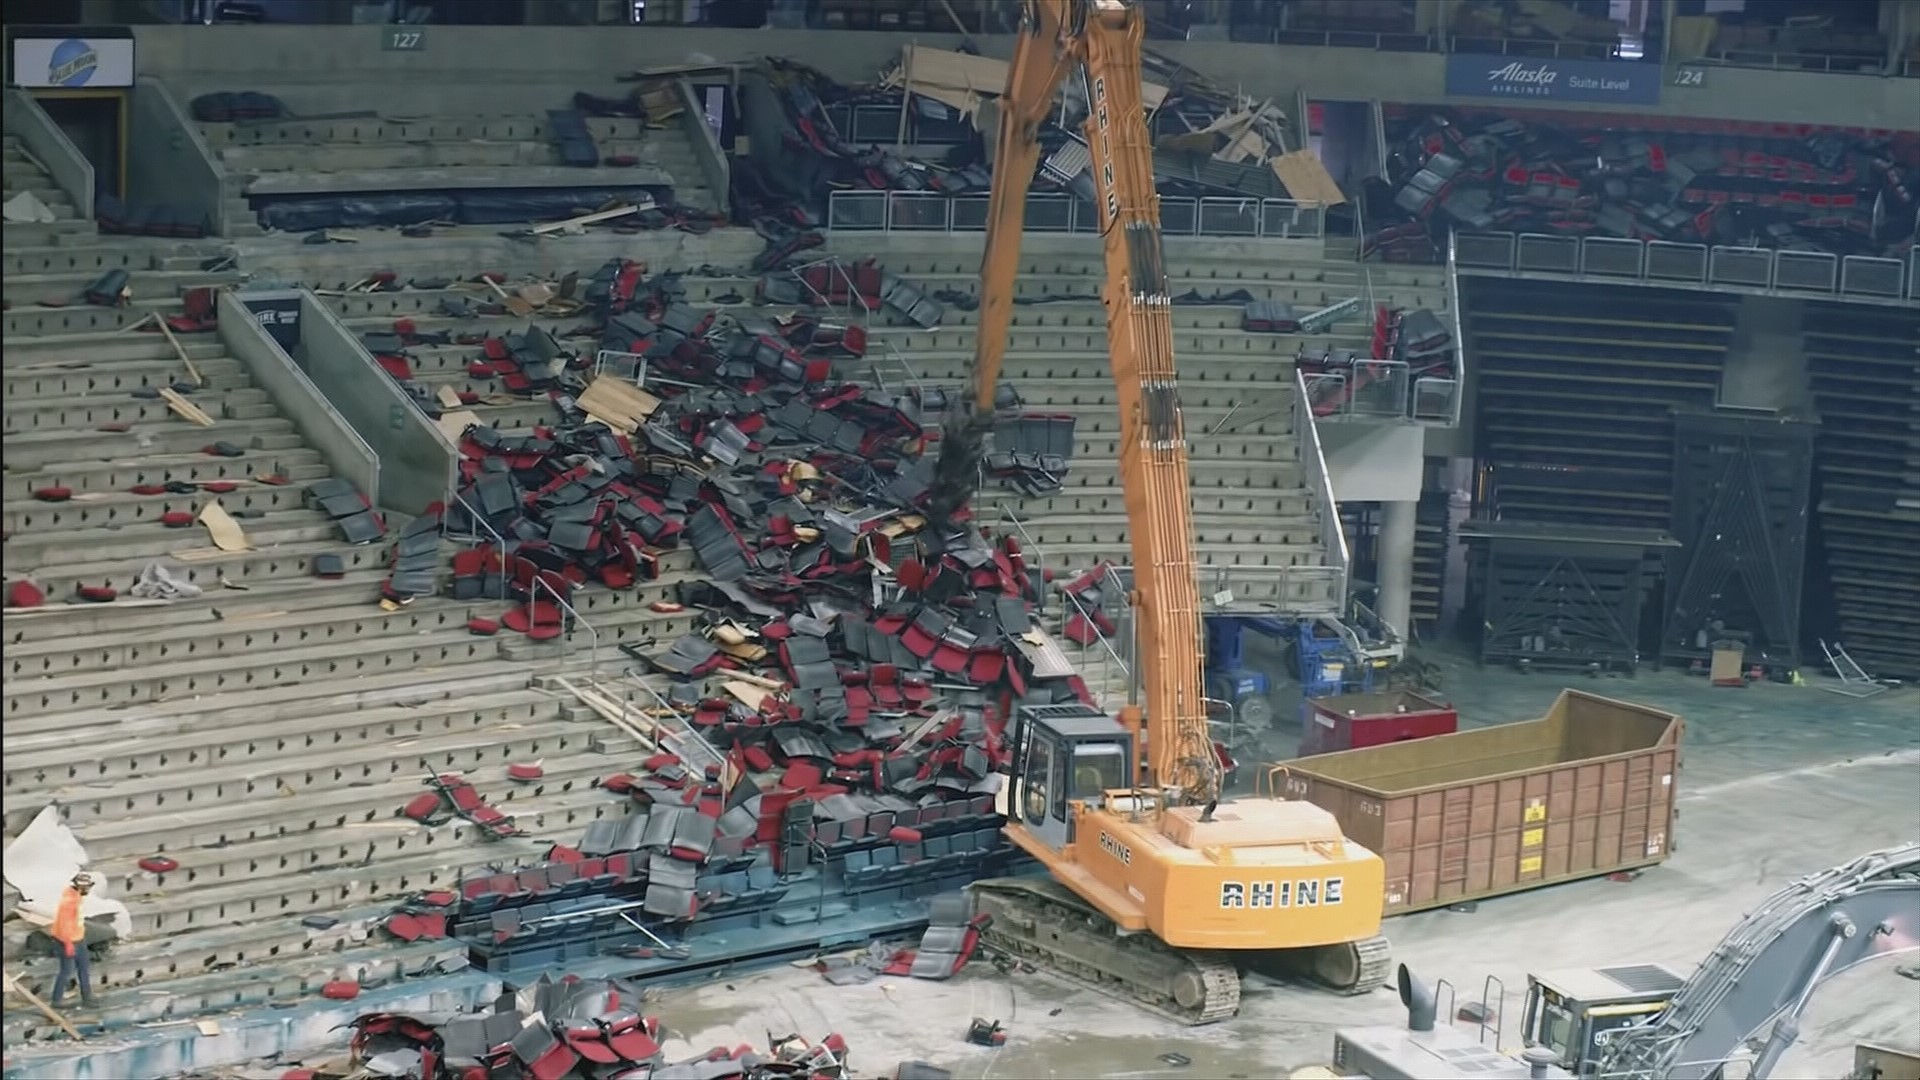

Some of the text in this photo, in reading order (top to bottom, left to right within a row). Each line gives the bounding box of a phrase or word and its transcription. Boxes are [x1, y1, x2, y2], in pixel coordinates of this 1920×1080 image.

[393, 33, 420, 48] 127
[1487, 61, 1558, 86] Alaska
[1569, 76, 1630, 90] Suite Level
[1491, 85, 1551, 95] AIRLINES
[1095, 78, 1117, 219] RHINE
[1099, 832, 1131, 866] RHINE
[1221, 877, 1343, 910] RHINE
